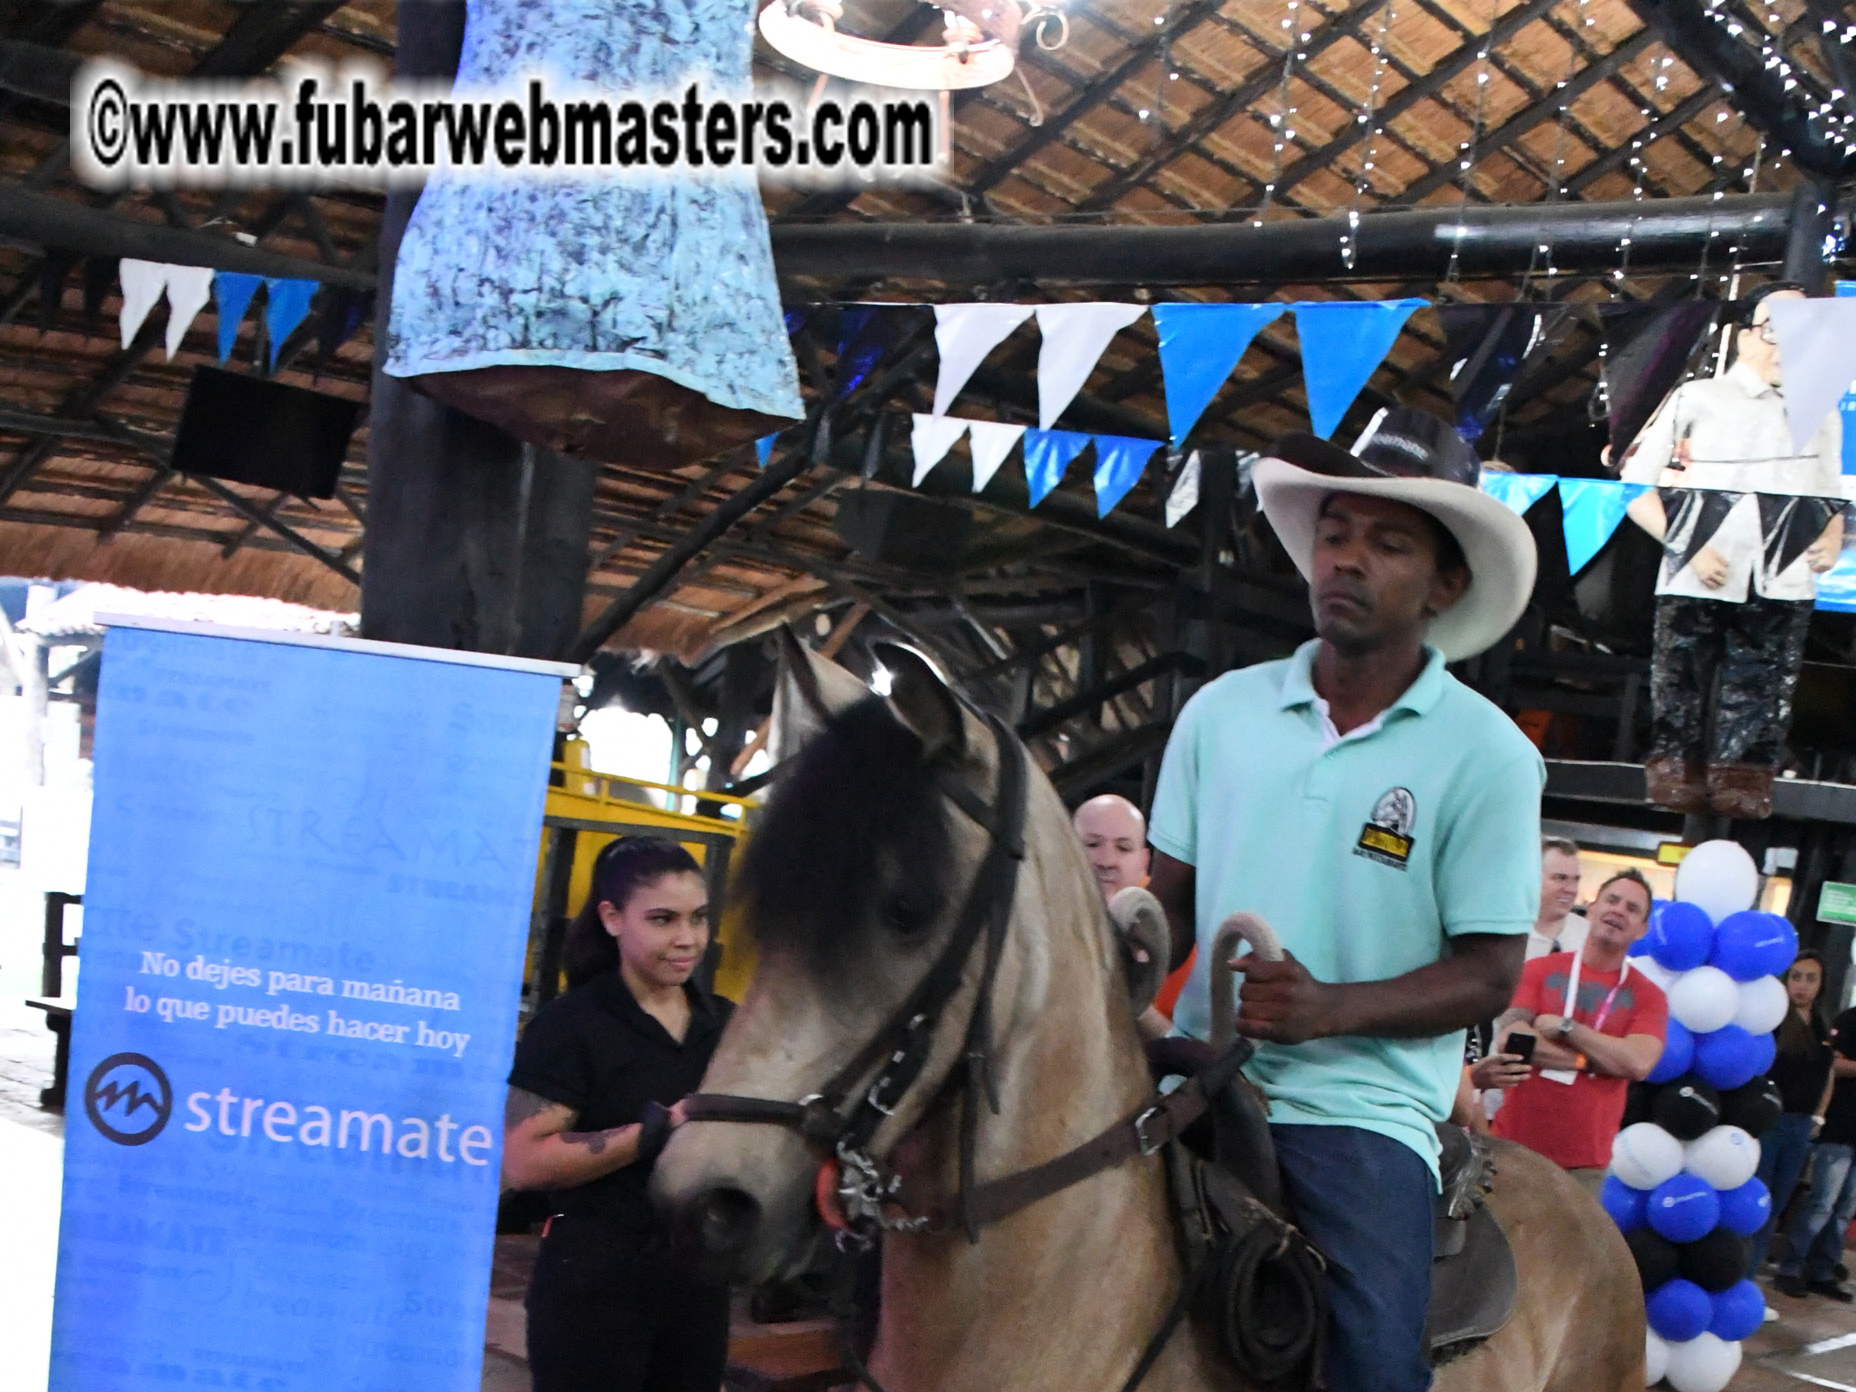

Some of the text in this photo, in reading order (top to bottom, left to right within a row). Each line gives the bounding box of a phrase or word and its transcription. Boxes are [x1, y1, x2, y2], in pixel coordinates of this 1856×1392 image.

[139, 951, 460, 1011] No dejes para mañana
[123, 986, 150, 1012] lo
[156, 995, 210, 1023] que
[215, 1002, 321, 1033] puedes
[328, 1015, 410, 1043] hacer
[416, 1021, 471, 1056] hoy
[184, 1087, 493, 1166] streamate
